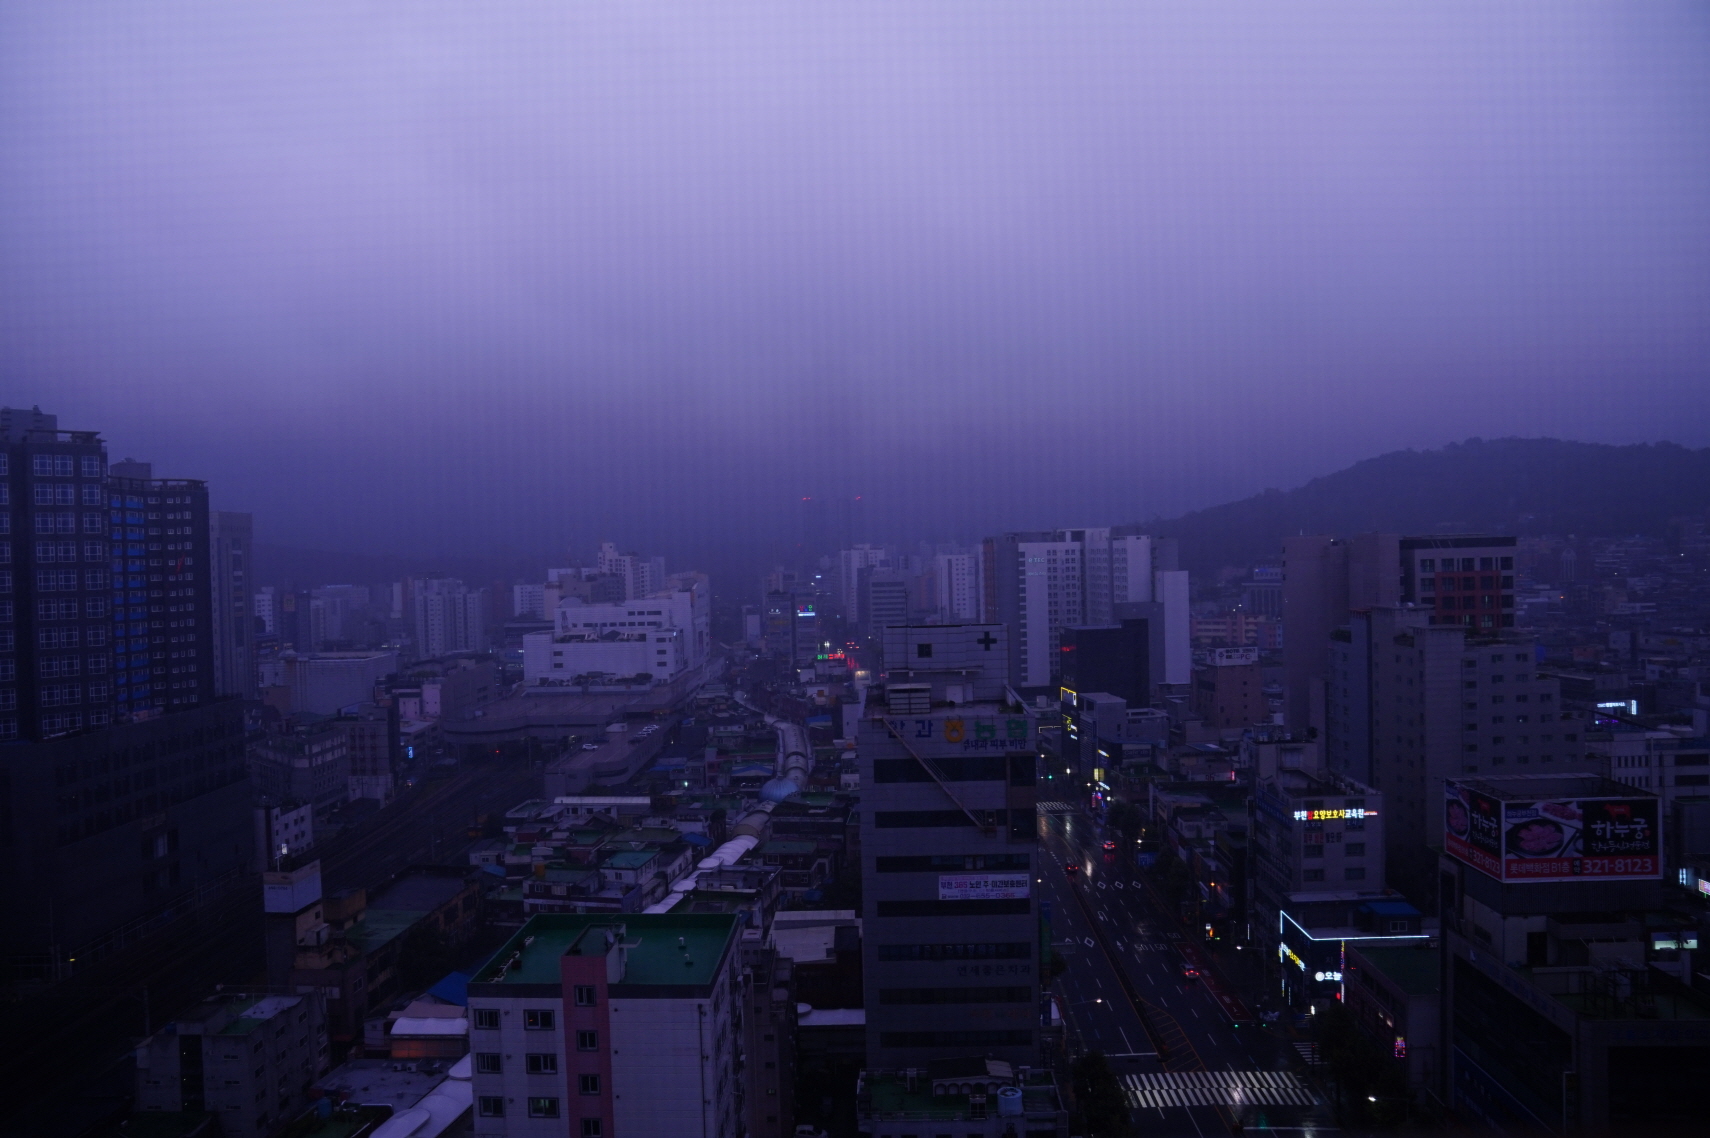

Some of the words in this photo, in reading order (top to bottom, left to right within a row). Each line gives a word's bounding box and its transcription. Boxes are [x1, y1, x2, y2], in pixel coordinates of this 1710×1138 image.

[975, 719, 1028, 740] 농협
[1008, 738, 1027, 750] 비만
[1590, 817, 1648, 839] 하누궁
[1510, 862, 1550, 874] 롯데백화점
[1583, 858, 1653, 874] 321-8123
[954, 880, 968, 889] 365
